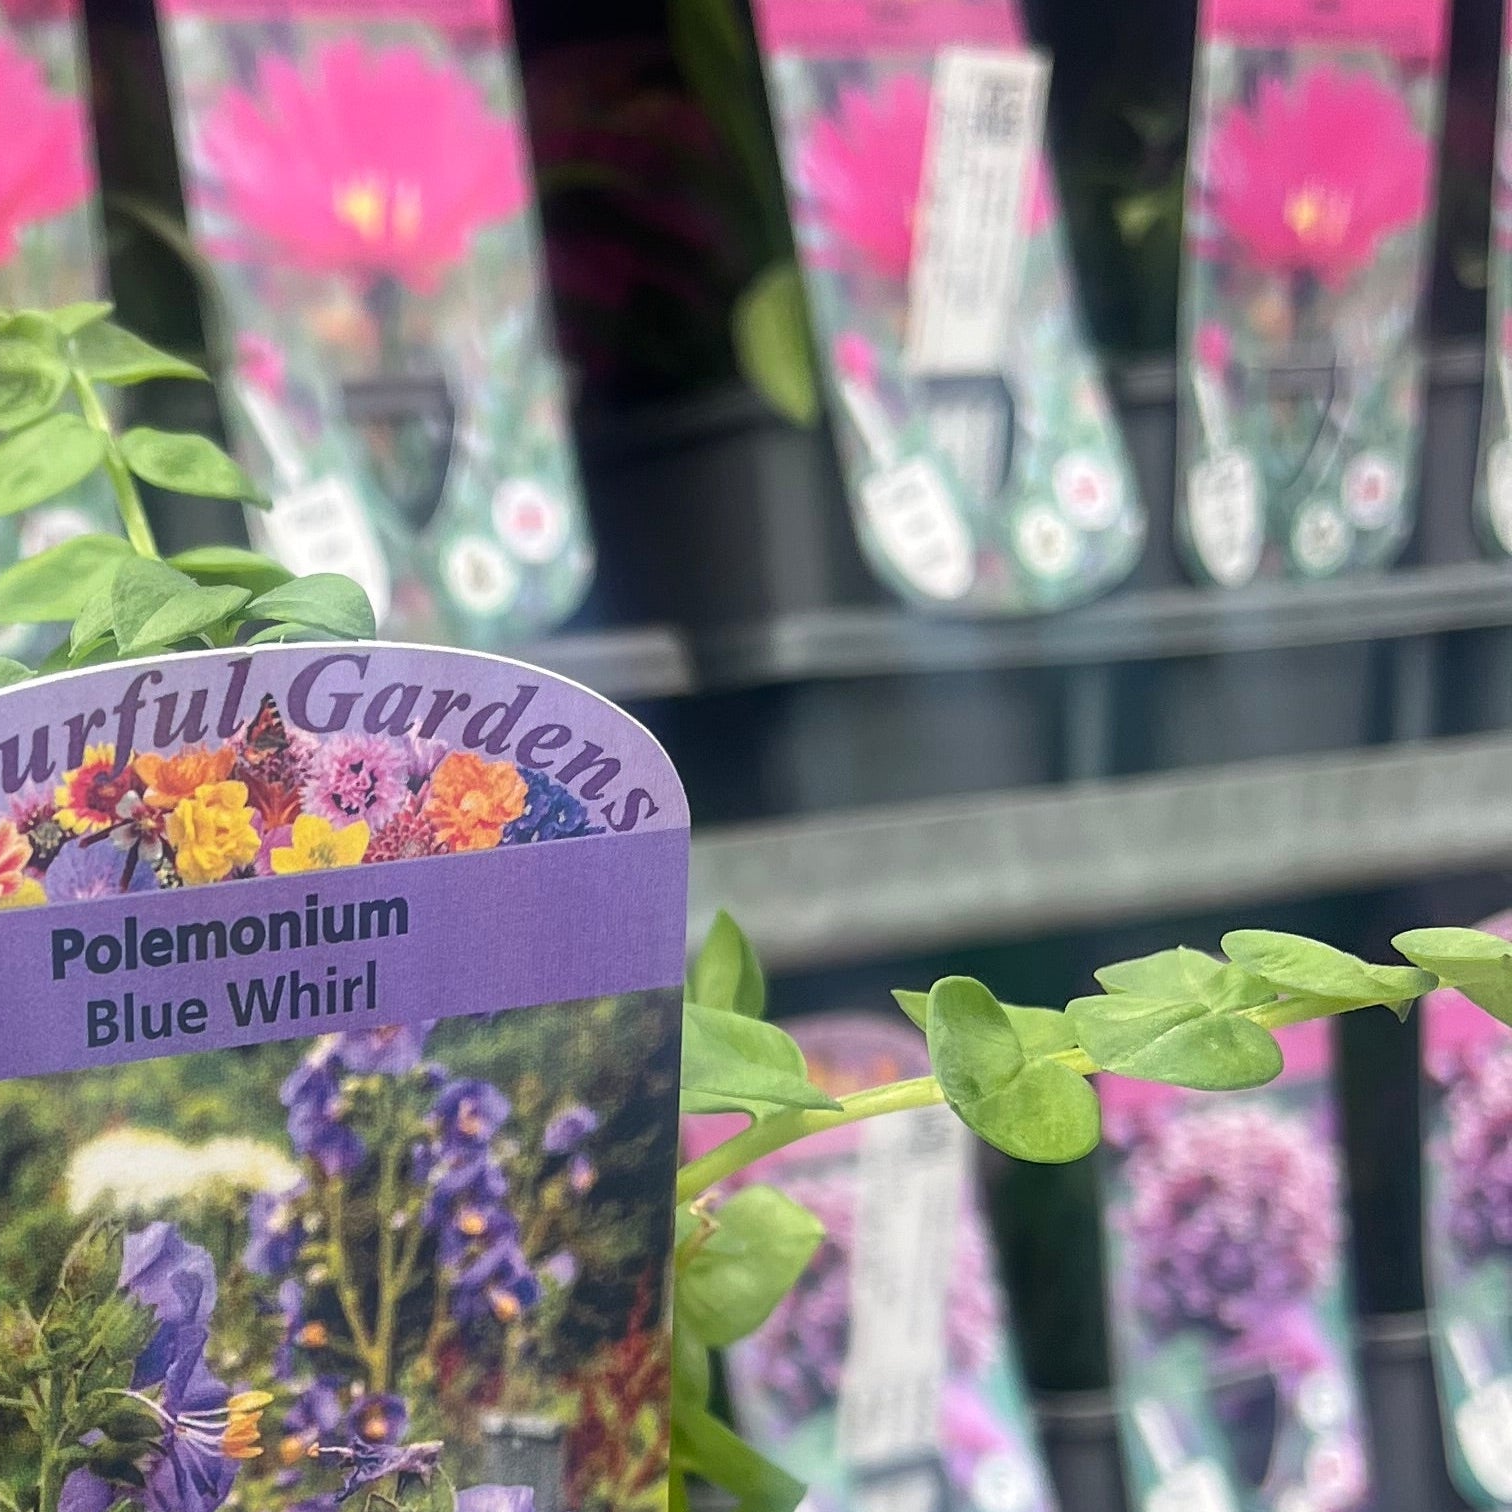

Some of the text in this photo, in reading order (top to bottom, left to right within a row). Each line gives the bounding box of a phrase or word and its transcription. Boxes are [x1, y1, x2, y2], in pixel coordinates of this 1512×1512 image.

[286, 654, 659, 832] Gardens
[52, 893, 409, 979] Polemonium
[88, 961, 377, 1048] Blue Whirl
